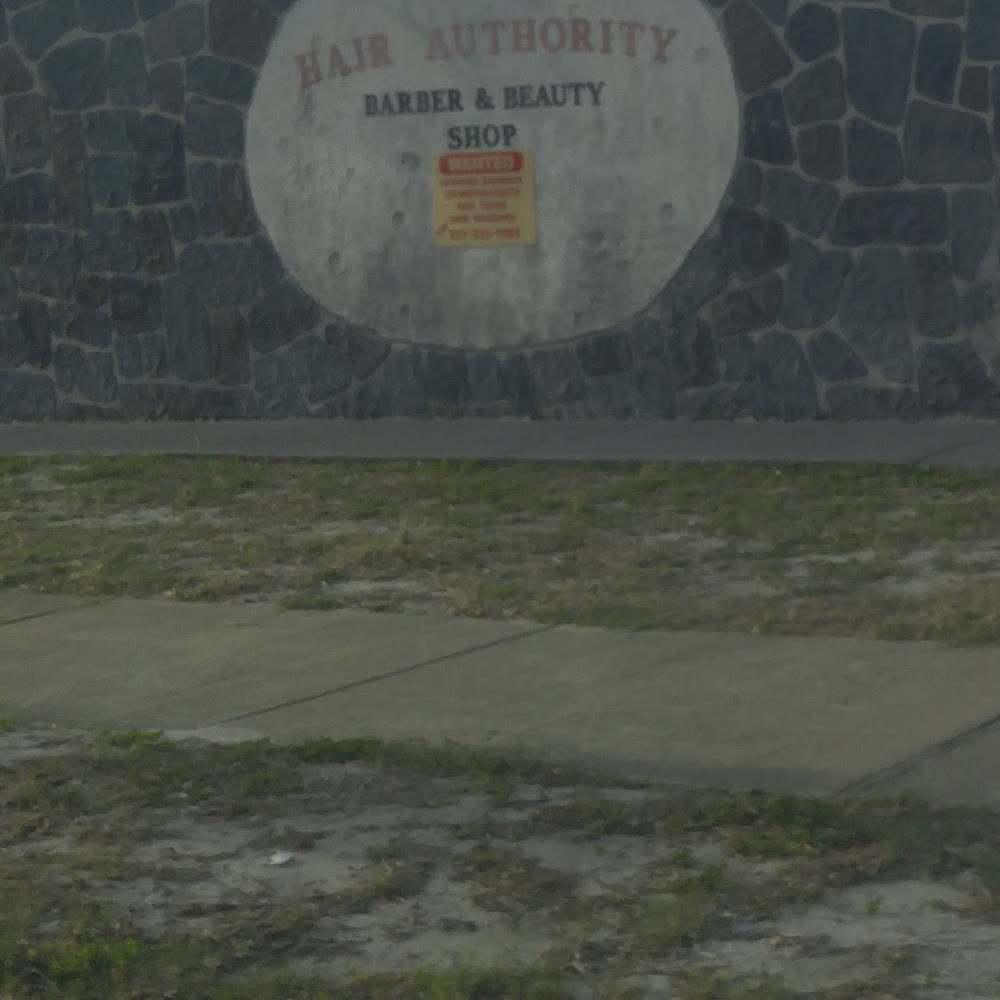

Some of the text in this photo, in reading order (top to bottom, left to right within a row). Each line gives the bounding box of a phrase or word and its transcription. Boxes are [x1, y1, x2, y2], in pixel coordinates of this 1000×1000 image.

[295, 17, 679, 90] HAIR AUTHORITY
[364, 82, 606, 118] BARBER & BEAUTY
[447, 124, 518, 149] SHOP
